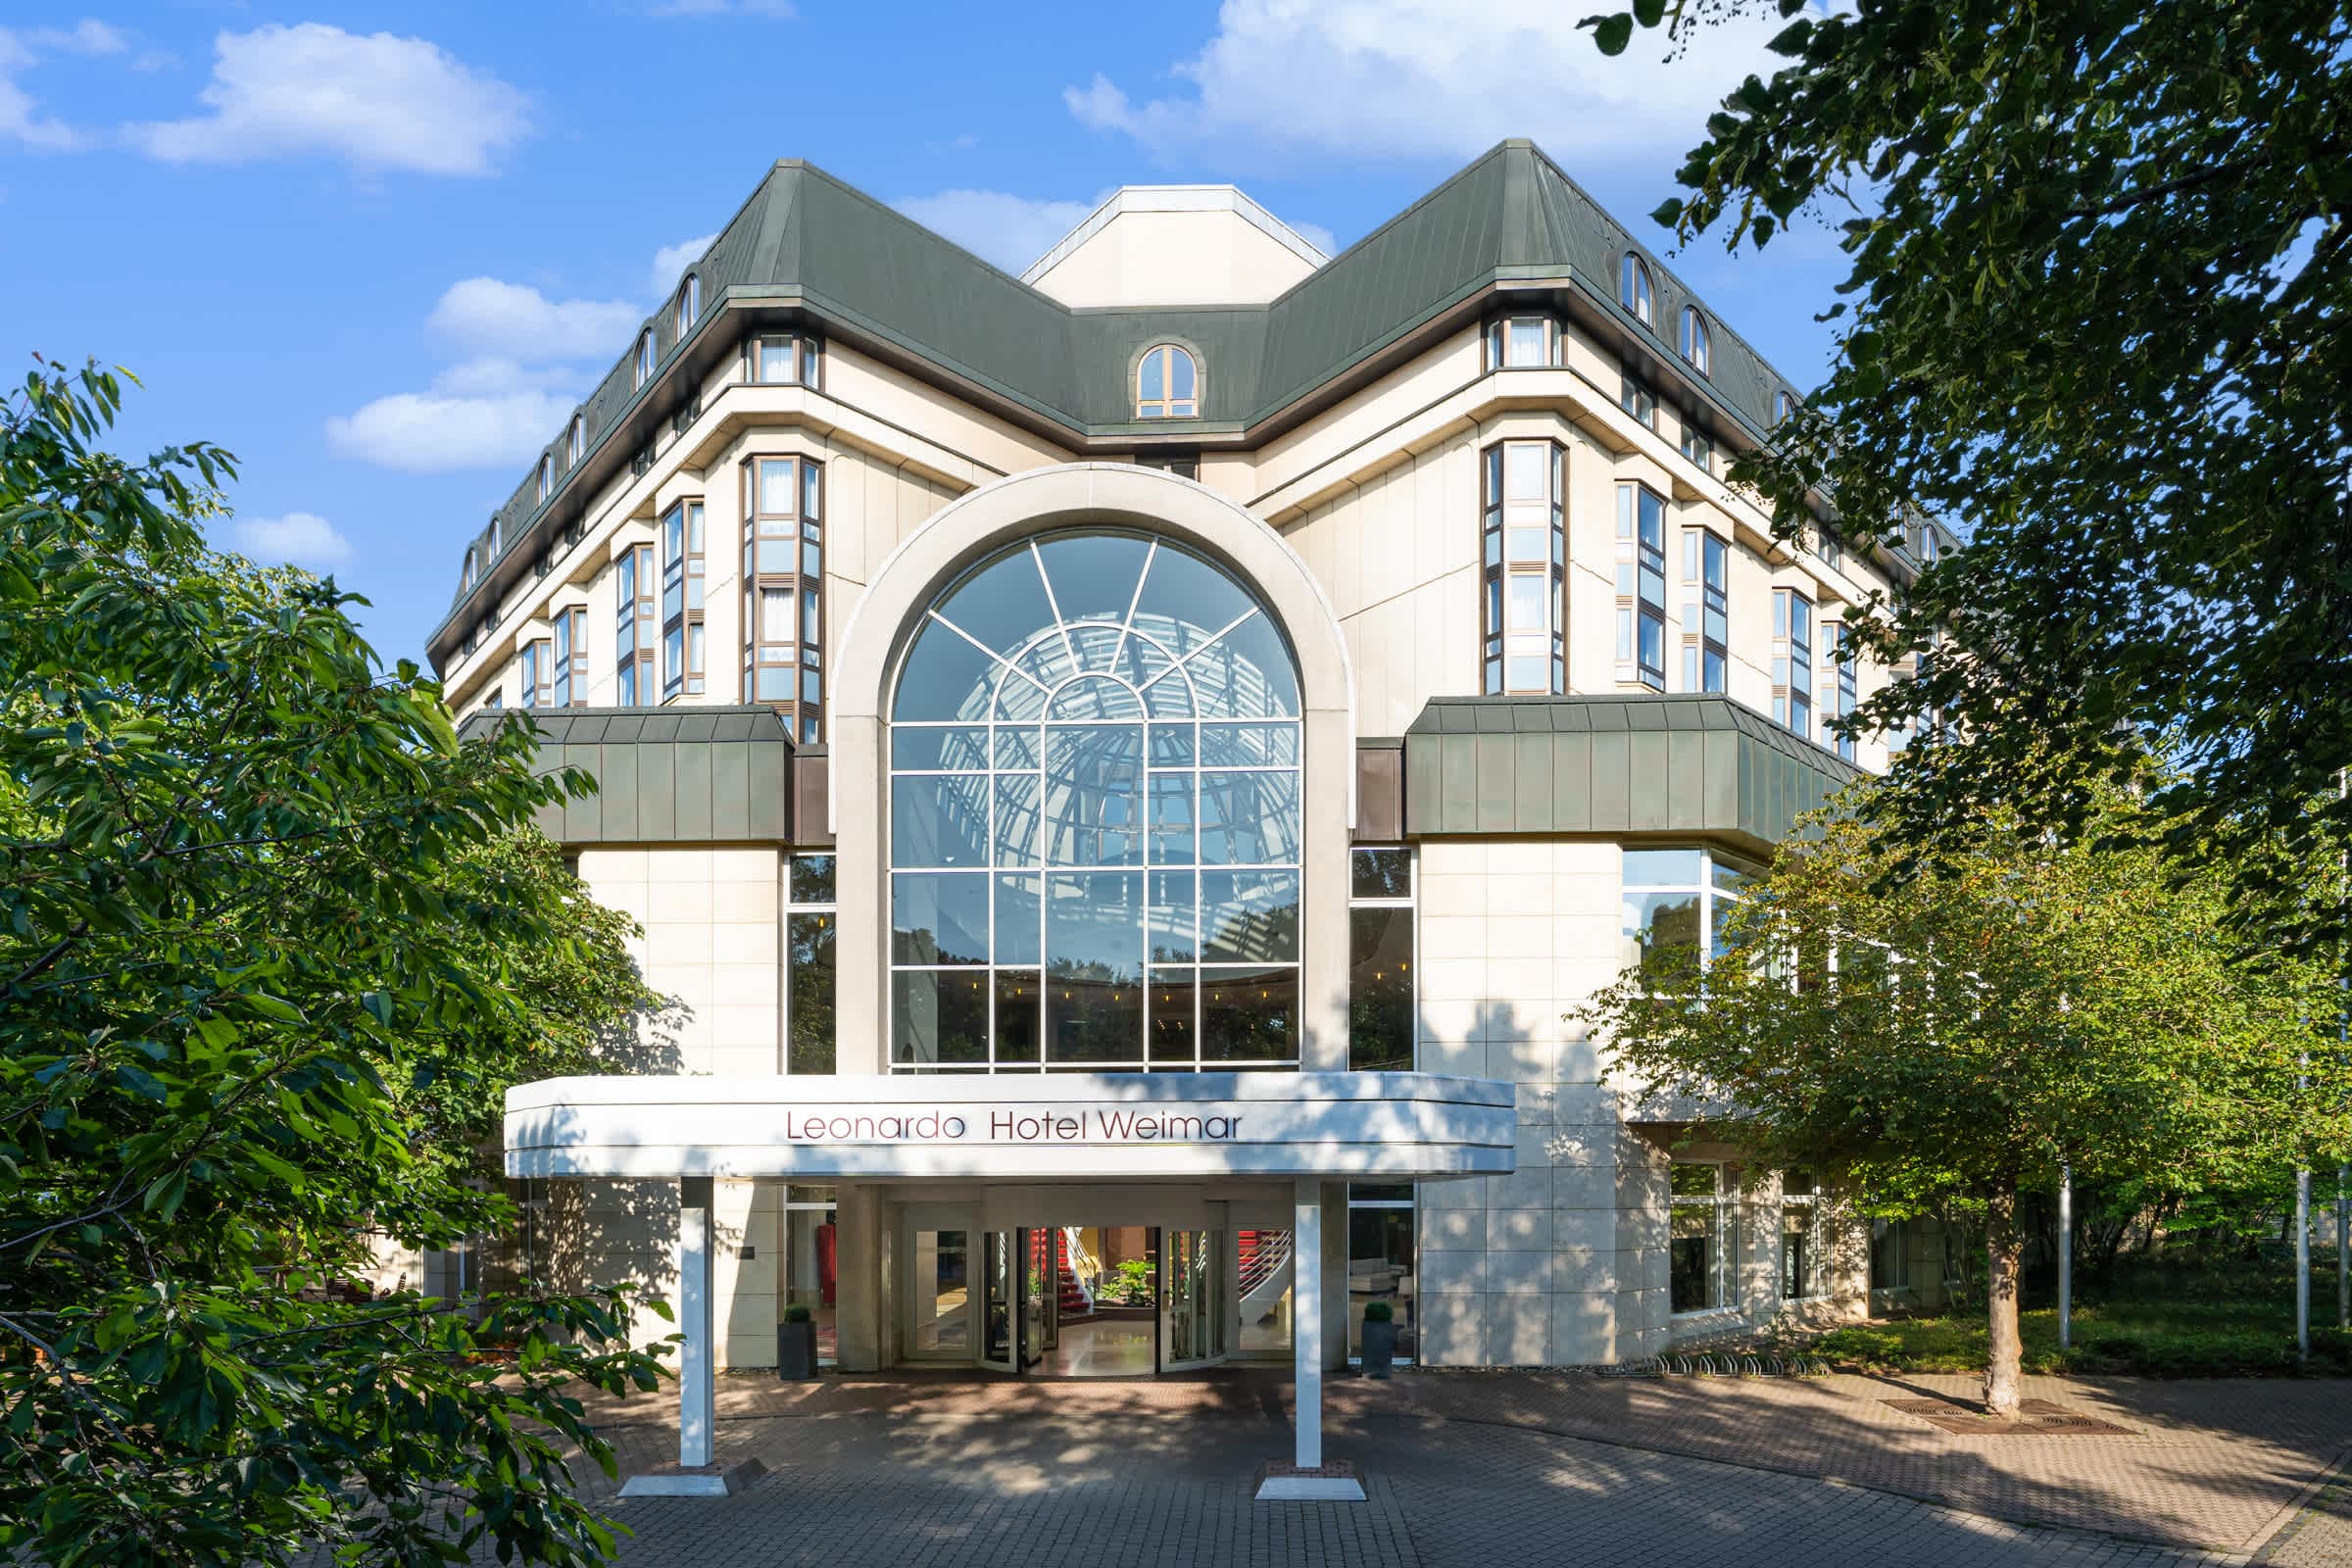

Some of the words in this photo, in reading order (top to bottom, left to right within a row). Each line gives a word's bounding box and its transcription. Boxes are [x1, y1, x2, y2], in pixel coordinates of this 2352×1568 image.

[787, 1111, 965, 1140] Leonardo
[991, 1111, 1086, 1140] Hotel
[1099, 1110, 1242, 1140] Weimar
